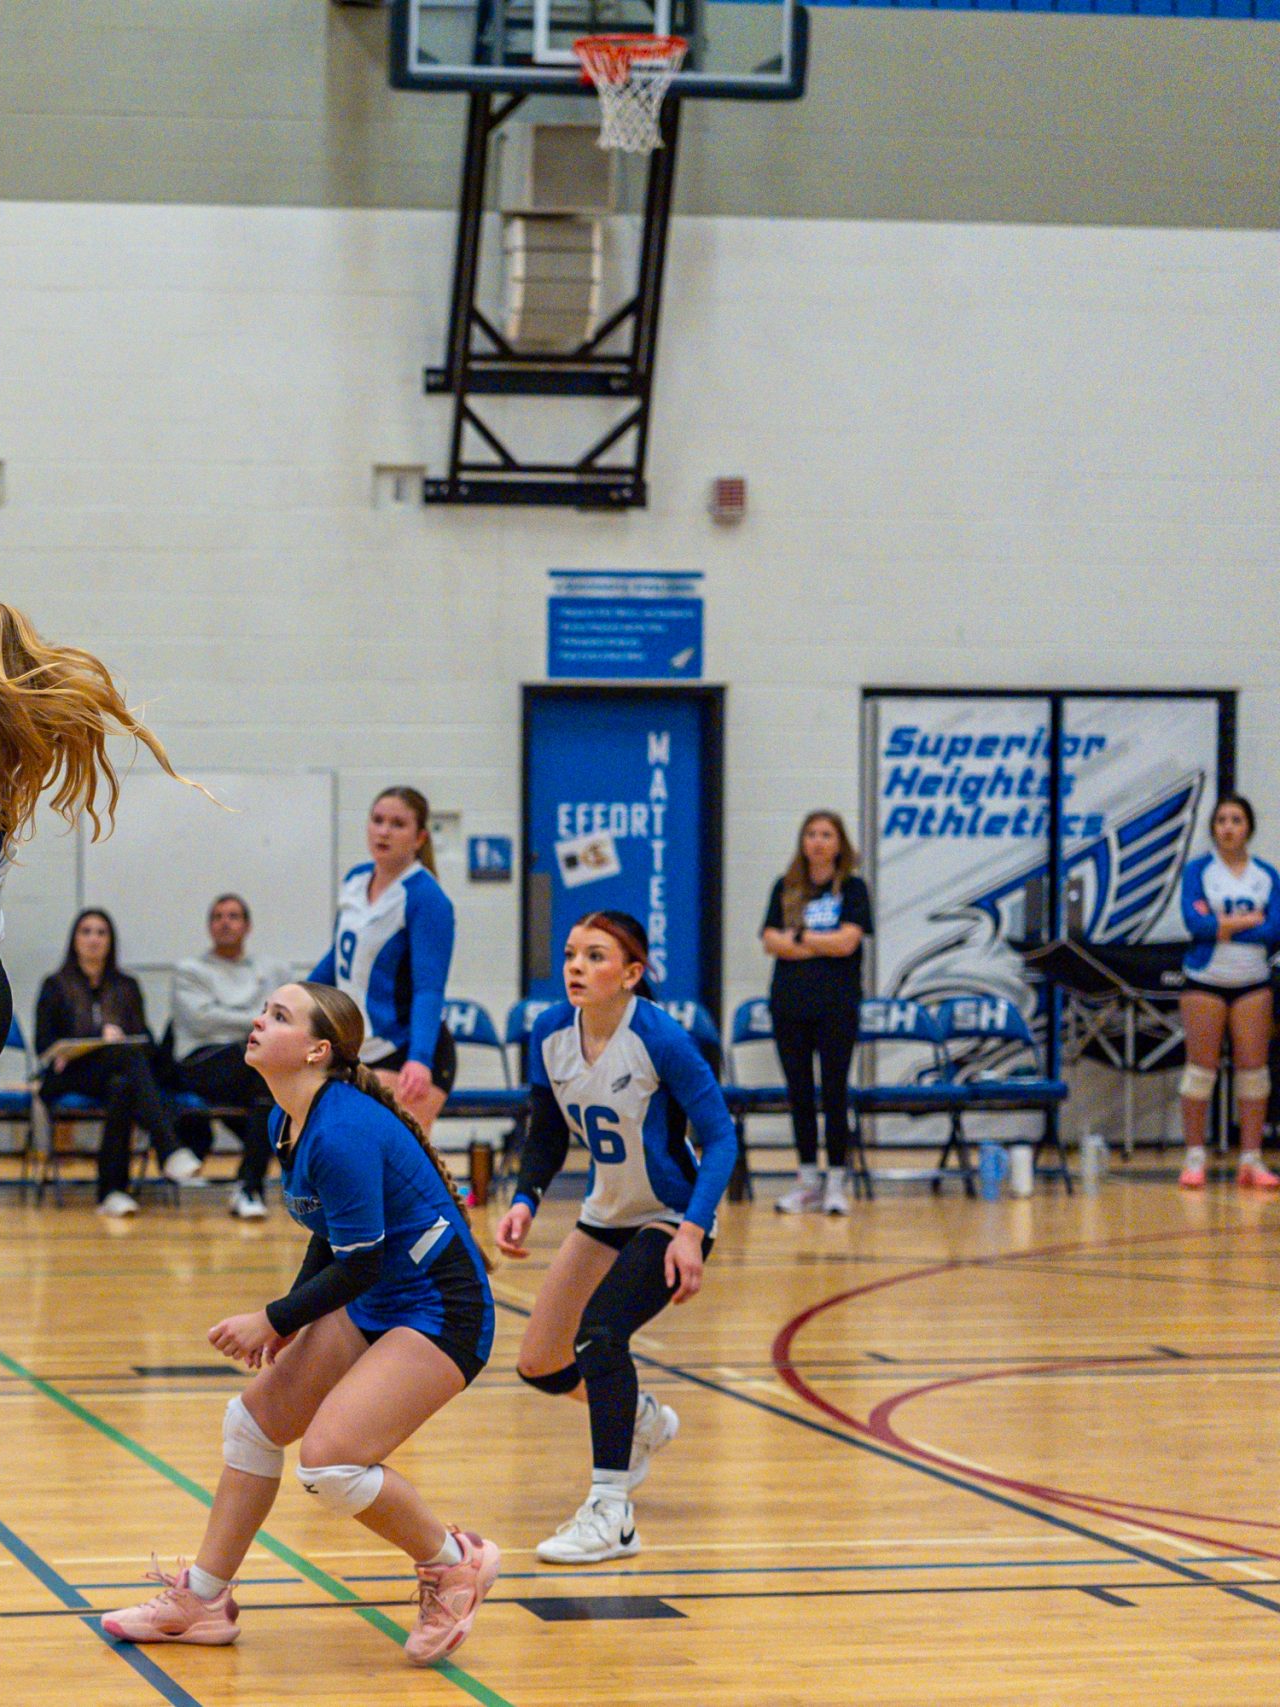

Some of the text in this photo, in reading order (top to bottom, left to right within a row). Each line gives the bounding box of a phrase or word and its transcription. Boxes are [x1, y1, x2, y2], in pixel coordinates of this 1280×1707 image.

[884, 726, 1107, 766] Superior
[883, 766, 1077, 806] Heights
[557, 802, 667, 839] EFFORT
[883, 805, 1105, 838] Athletics
[647, 730, 670, 984] MATTERS
[339, 930, 358, 981] 9
[859, 1001, 919, 1033] SH
[953, 999, 1009, 1032] SH
[567, 1103, 627, 1165] 16
